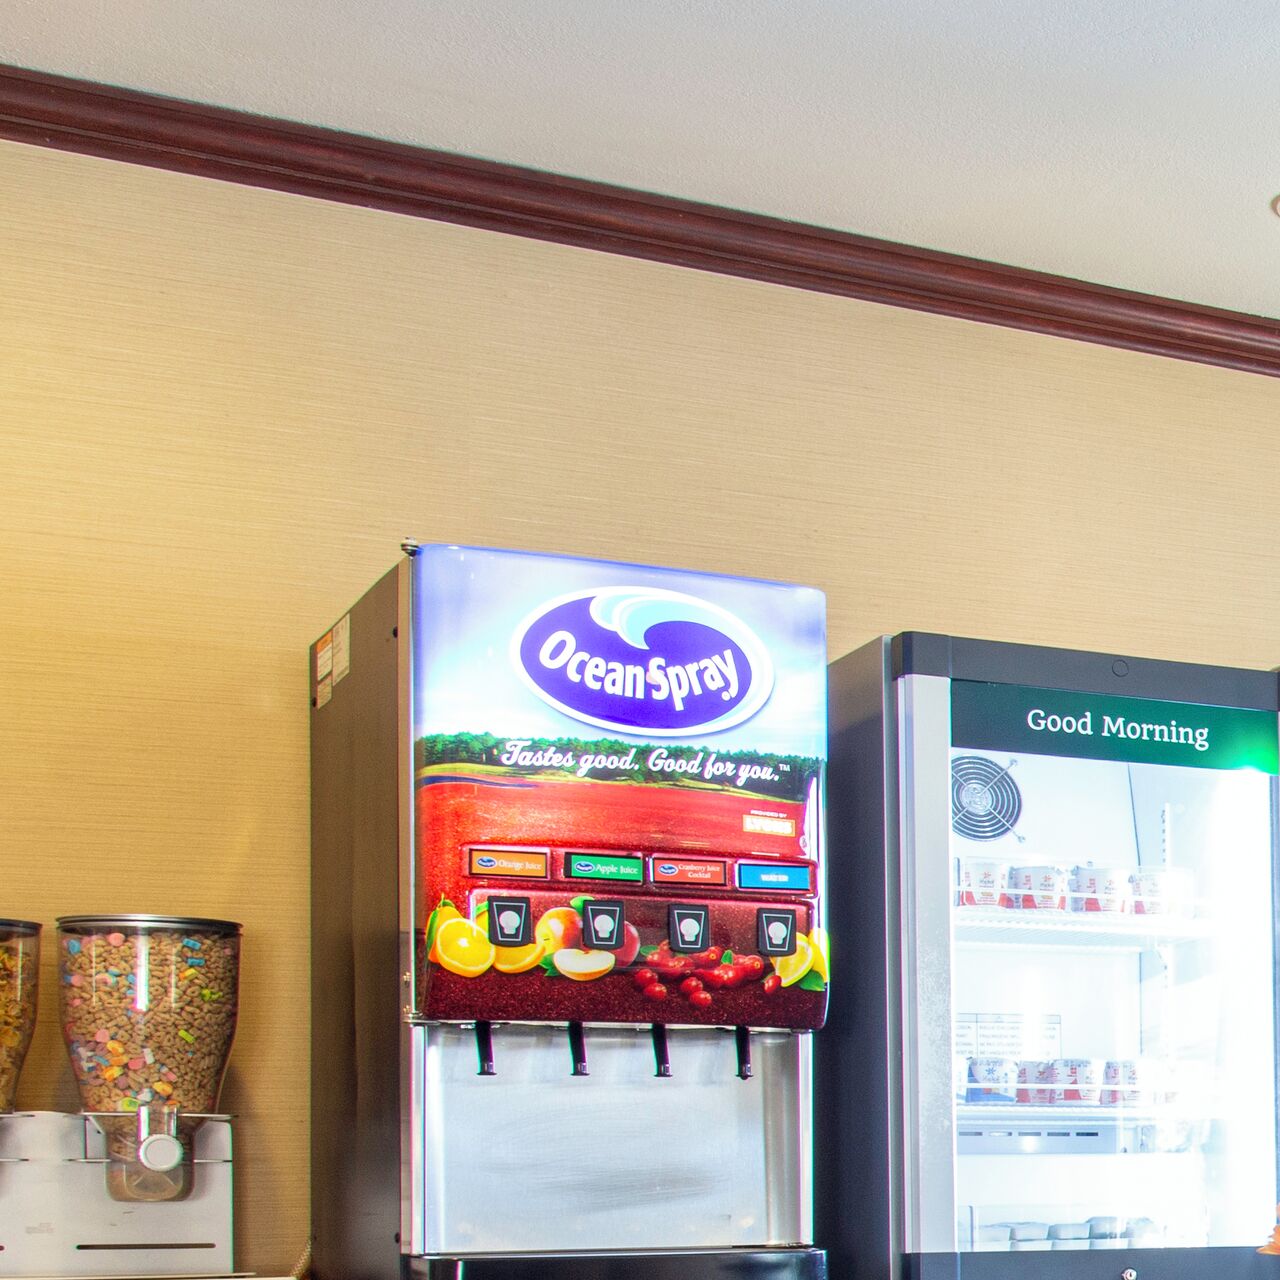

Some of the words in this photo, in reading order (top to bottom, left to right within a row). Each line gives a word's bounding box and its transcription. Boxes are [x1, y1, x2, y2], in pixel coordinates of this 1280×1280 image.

[1027, 708, 1093, 736] Good
[1101, 715, 1210, 751] Morning
[501, 740, 575, 768] Tastes
[579, 748, 640, 777] good.
[648, 748, 702, 773] Good
[702, 753, 736, 779] for
[498, 859, 524, 871] Orange
[525, 861, 542, 870] Juice
[595, 863, 618, 875] Apple
[620, 865, 639, 874] Juice
[678, 863, 705, 872] Cranberry
[687, 871, 711, 879] Cocktail
